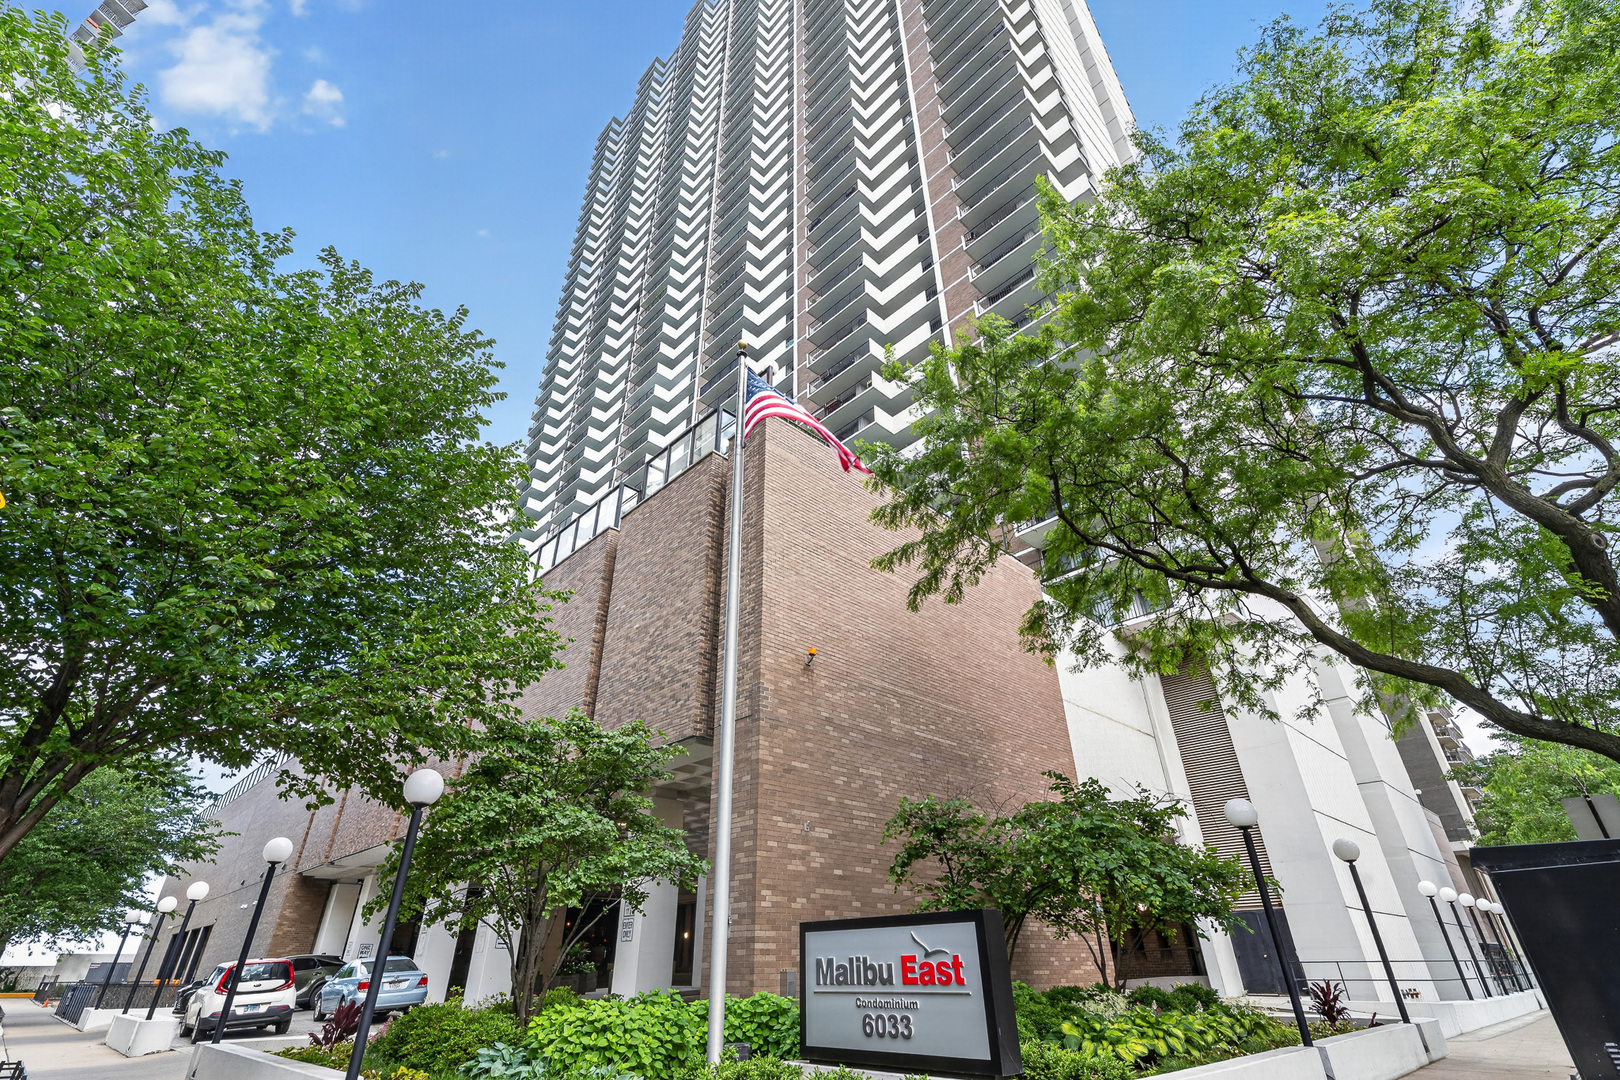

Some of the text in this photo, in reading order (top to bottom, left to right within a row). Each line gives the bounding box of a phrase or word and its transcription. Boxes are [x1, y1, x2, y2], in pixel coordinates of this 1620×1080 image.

[815, 954, 966, 986] Malibu East
[855, 997, 919, 1010] Condominium
[862, 1013, 914, 1040] 6033
